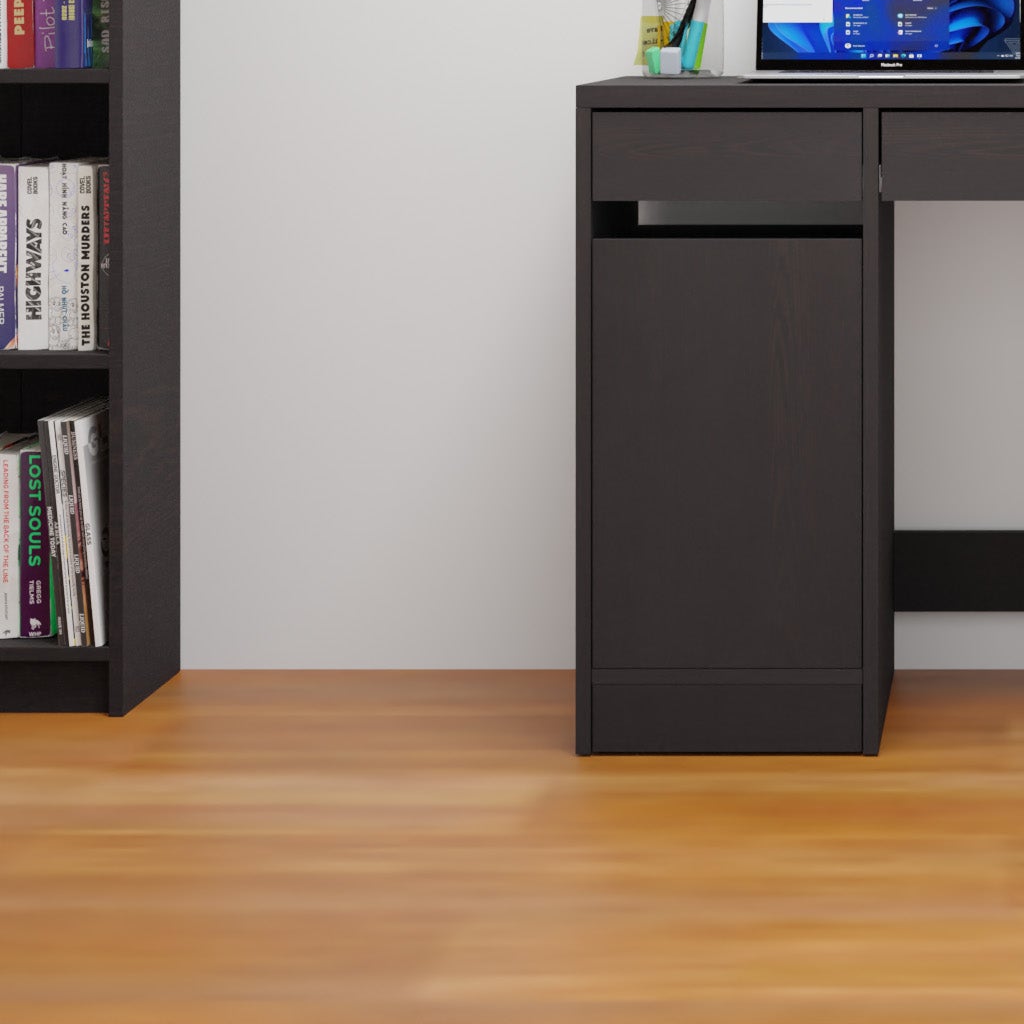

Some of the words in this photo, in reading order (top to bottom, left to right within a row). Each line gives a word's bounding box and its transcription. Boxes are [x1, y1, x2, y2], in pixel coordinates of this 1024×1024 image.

[39, 10, 55, 52] Pilot
[101, 29, 110, 53] SAD
[81, 205, 90, 260] MURDERS
[26, 218, 42, 320] HIGHWAYS
[81, 263, 90, 321] HOUSTON
[81, 324, 90, 346] THE
[28, 454, 42, 501] LOST
[3, 544, 9, 553] OF
[28, 505, 42, 567] SOULS
